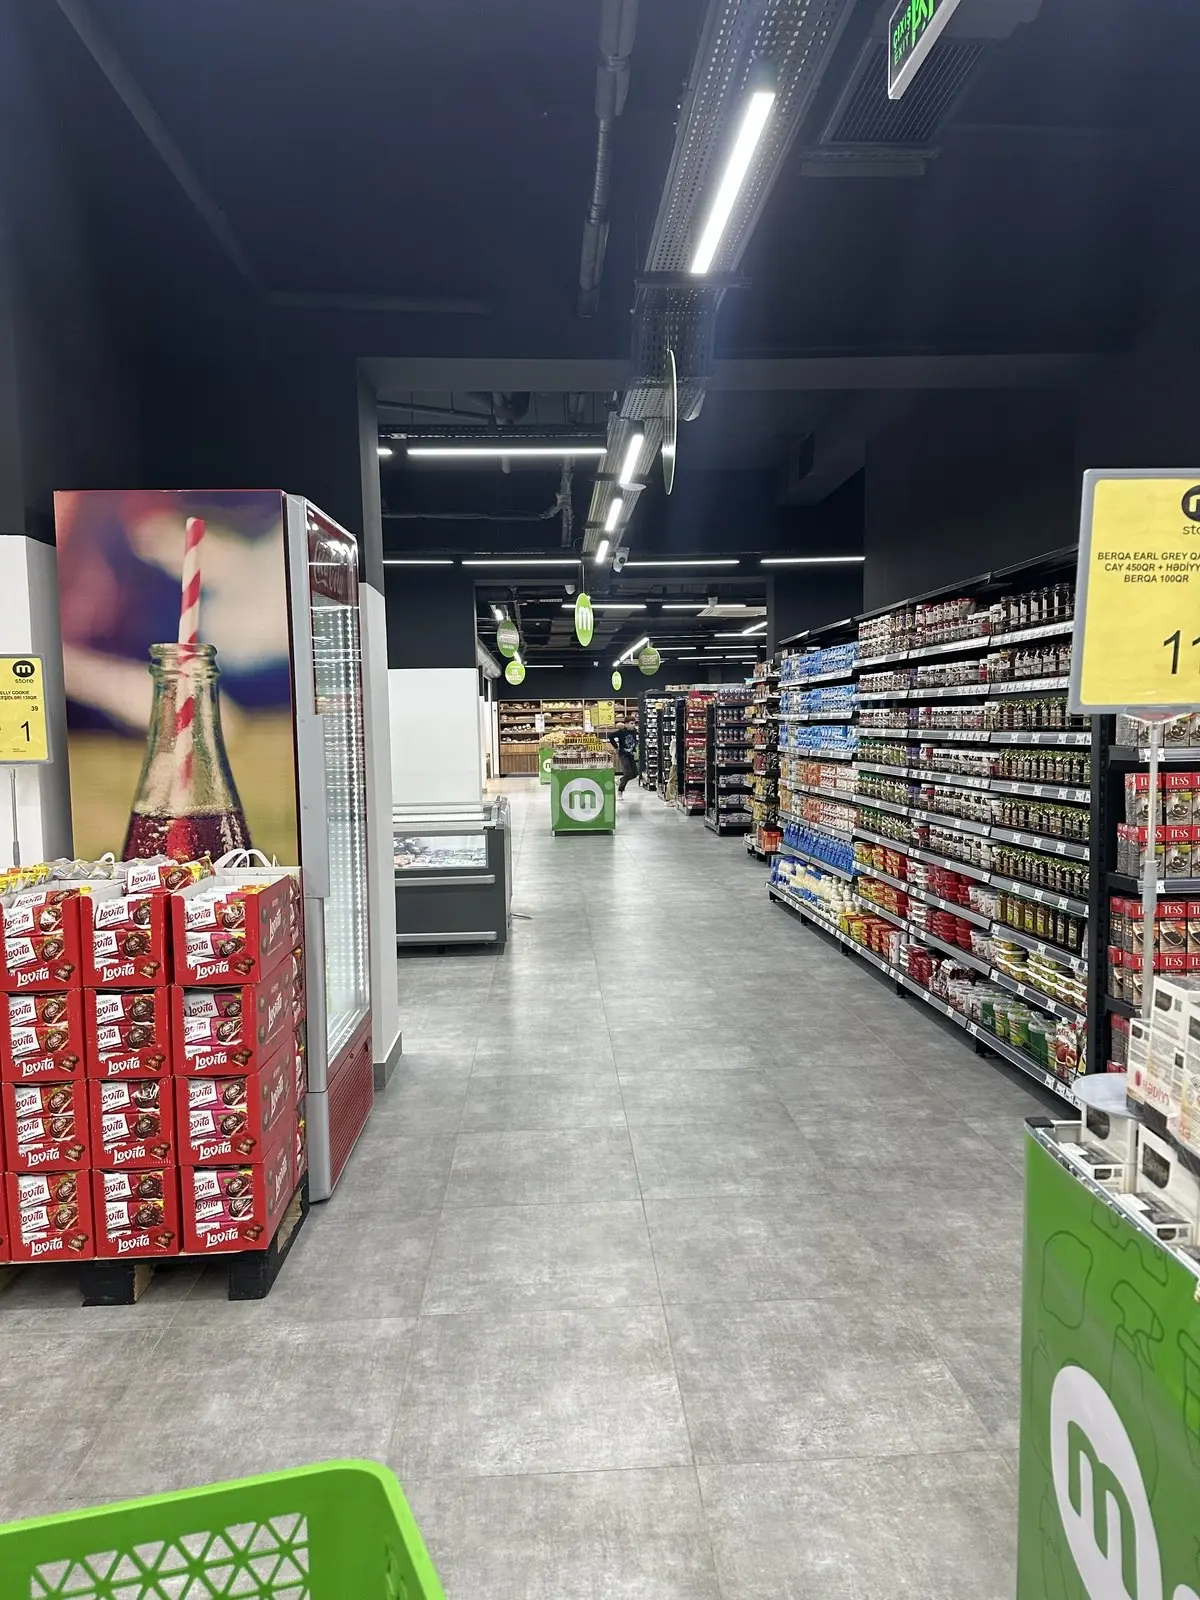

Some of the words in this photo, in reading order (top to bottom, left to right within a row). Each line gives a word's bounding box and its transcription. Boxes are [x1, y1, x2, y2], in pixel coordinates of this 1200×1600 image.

[1097, 552, 1131, 561] BERQA
[1133, 552, 1159, 560] EARL
[1161, 552, 1188, 560] GREY
[1104, 563, 1124, 572] CAY
[1125, 563, 1156, 572] 450QR
[1124, 574, 1157, 583] BERQA
[1160, 574, 1189, 583] 100QR
[20, 720, 30, 742] 1
[1170, 776, 1189, 786] TESS
[568, 789, 597, 809] m
[1170, 829, 1189, 838] TESS
[131, 871, 156, 886] Lovita
[16, 894, 43, 907] Lovita
[99, 906, 126, 920] Lovita
[1162, 904, 1183, 914] TESS
[92, 935, 113, 951] ovita
[186, 939, 209, 954] ovita
[1164, 957, 1184, 967] TESS
[16, 966, 50, 988] Lovita
[102, 963, 135, 983] Lovita
[195, 961, 230, 981] Lovita
[9, 1002, 32, 1018] ovita
[97, 1002, 119, 1018] ovita
[188, 1001, 214, 1017] Lovita
[11, 1033, 34, 1049] ovita
[21, 1057, 55, 1077] Lovita
[107, 1057, 141, 1076] Lovita
[194, 1051, 228, 1071] Lovita
[102, 1089, 125, 1104] ovita
[189, 1084, 213, 1101] ovita
[15, 1095, 37, 1110] ovita
[17, 1118, 39, 1134] ovita
[102, 1119, 124, 1134] ovita
[189, 1115, 211, 1131] ovita
[27, 1147, 60, 1167] Lovita
[112, 1145, 146, 1165] Lovita
[199, 1141, 232, 1160] Lovita
[104, 1181, 126, 1196] ovita
[194, 1180, 216, 1195] ovita
[21, 1209, 44, 1226] ovita
[106, 1209, 125, 1226] vita
[117, 1233, 151, 1253] Lovita
[206, 1227, 239, 1248] Lovita
[31, 1236, 63, 1257] Lovita
